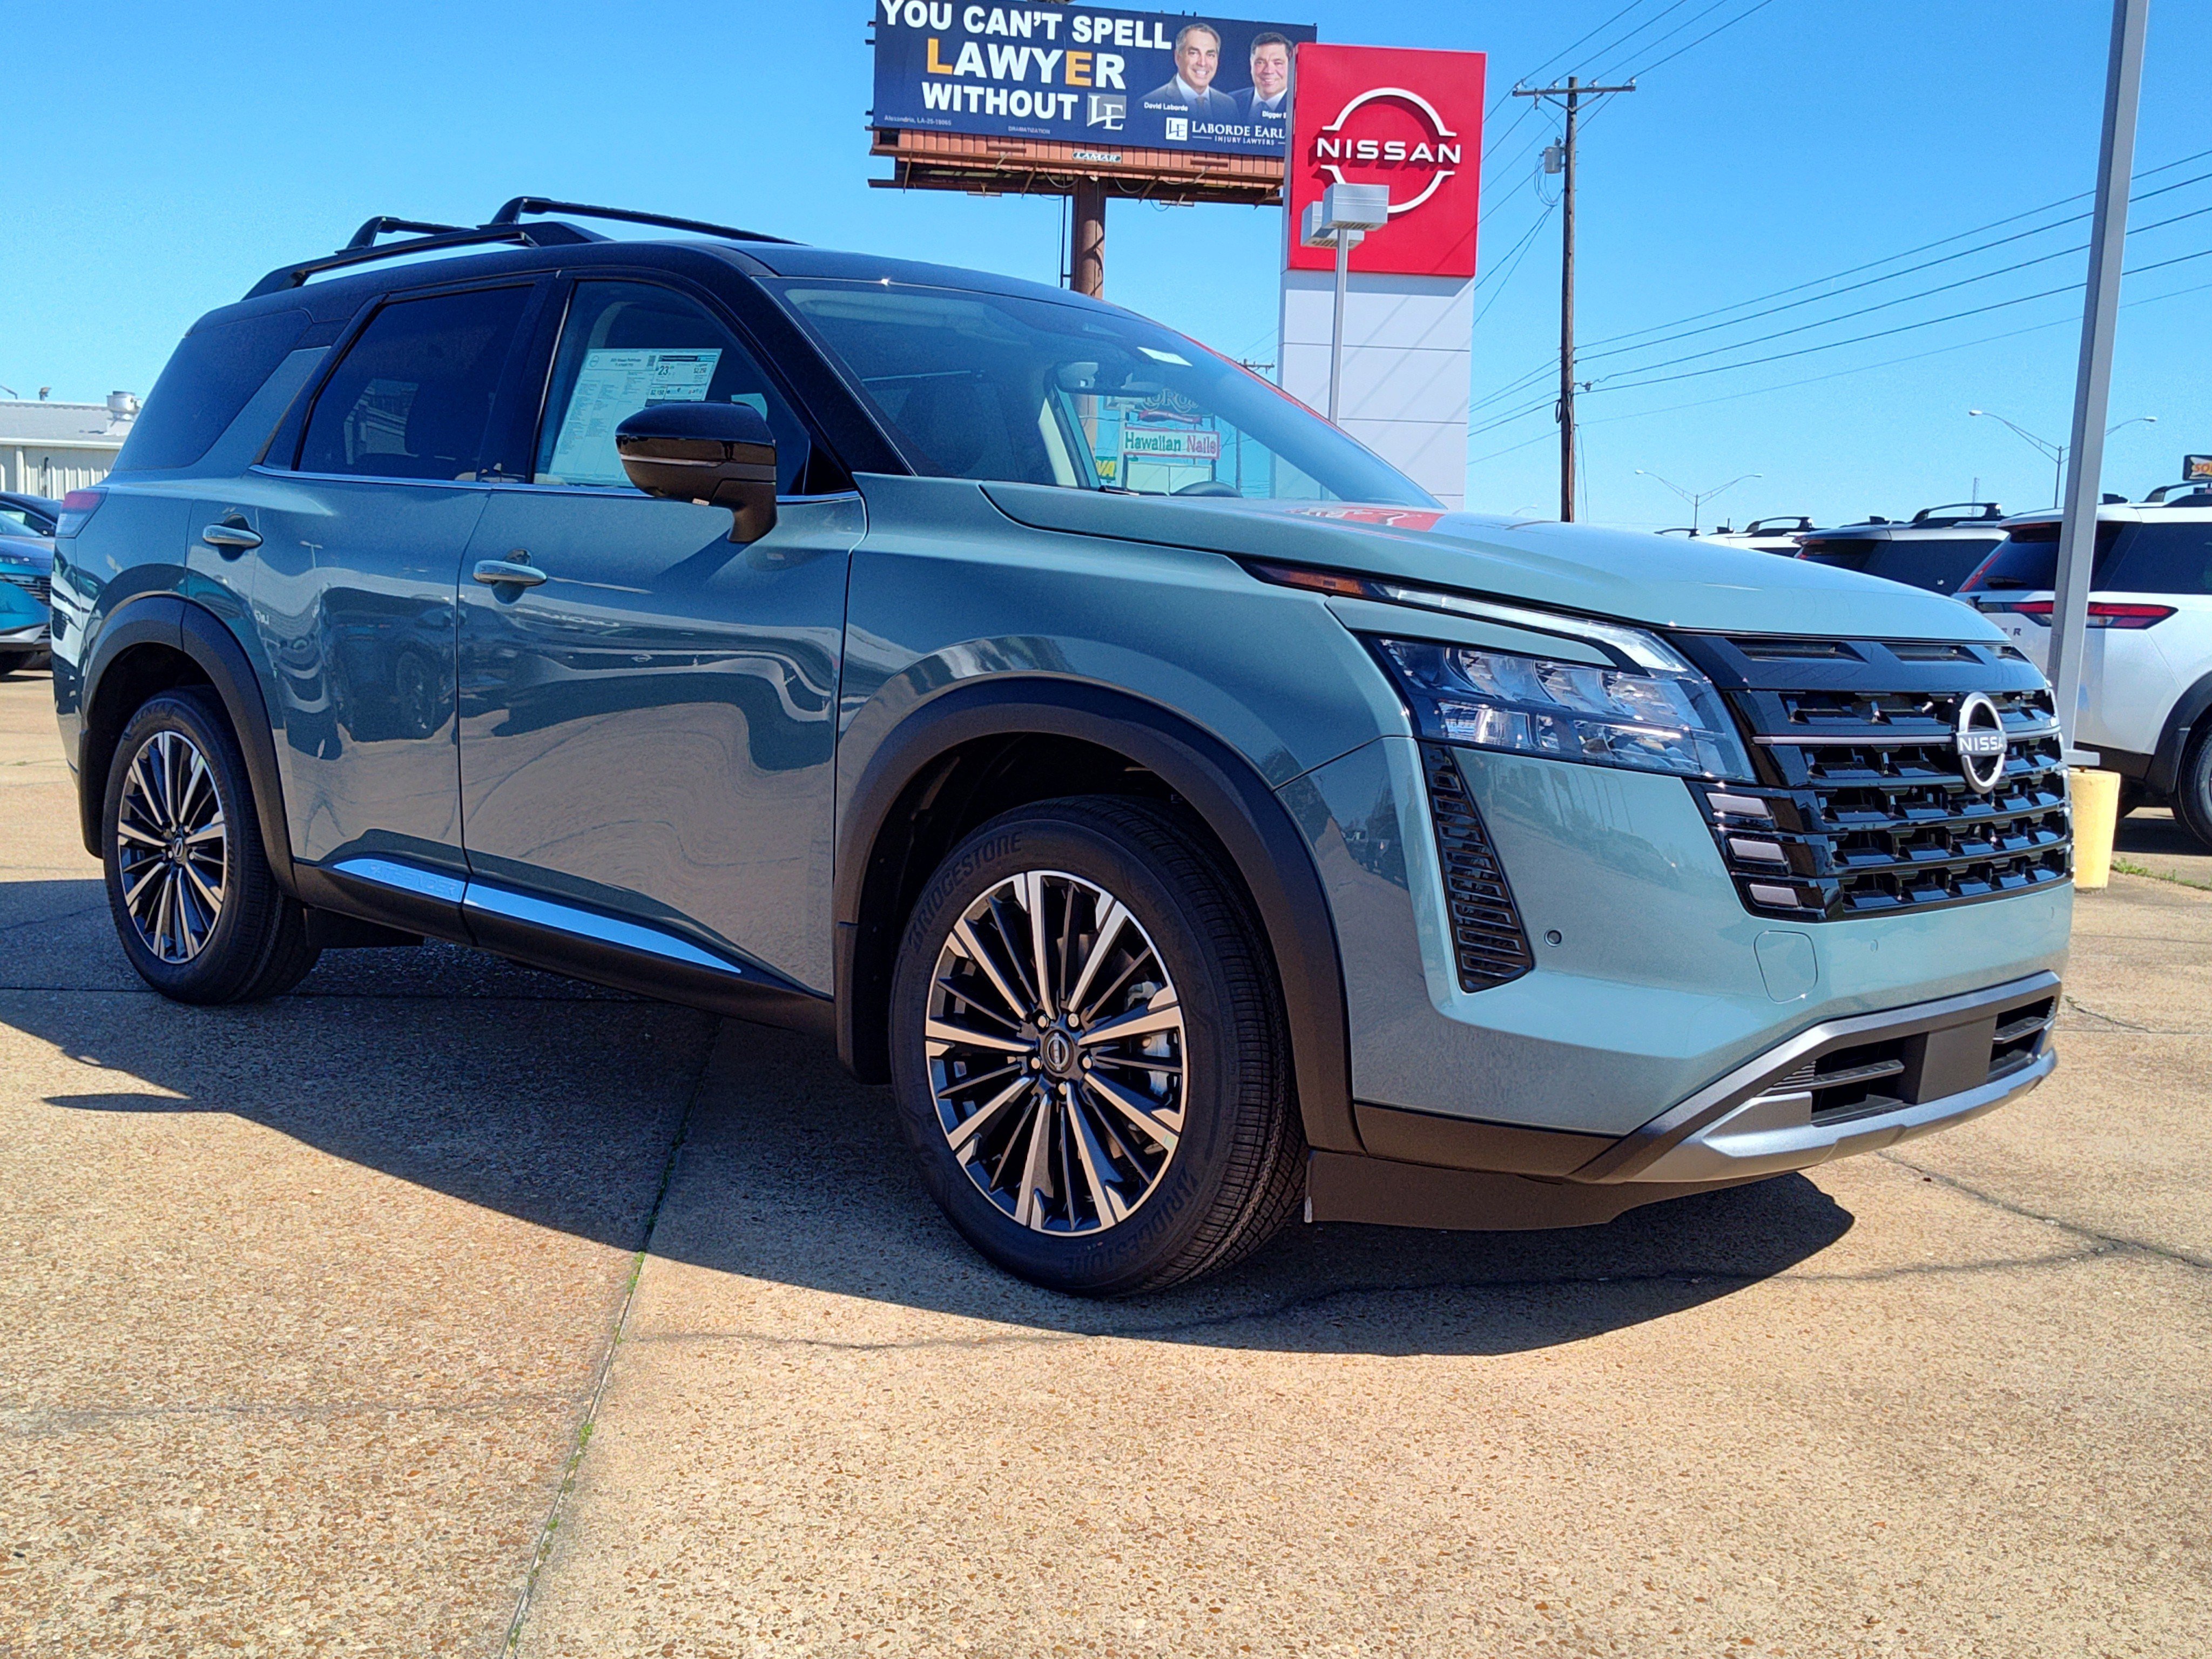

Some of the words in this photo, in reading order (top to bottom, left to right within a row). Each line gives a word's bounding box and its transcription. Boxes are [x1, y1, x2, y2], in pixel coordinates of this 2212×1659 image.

[880, 0, 952, 30] YOU
[963, 5, 1062, 41] CAN’T
[1071, 15, 1172, 50] SPELL
[927, 38, 1126, 90] LAWYER
[922, 82, 1078, 120] WITHOUT
[1144, 102, 1162, 110] David
[1163, 103, 1188, 111] Laborde
[1262, 110, 1282, 119] Digger
[1192, 120, 1251, 137] LABORDE
[1215, 136, 1242, 144] INJURY
[1243, 137, 1274, 146] LAWYERS
[1317, 138, 1461, 164] NISSAN
[1076, 152, 1118, 161] LAMAR
[1125, 431, 1182, 451] Hawaiian
[1187, 435, 1216, 454] Nails
